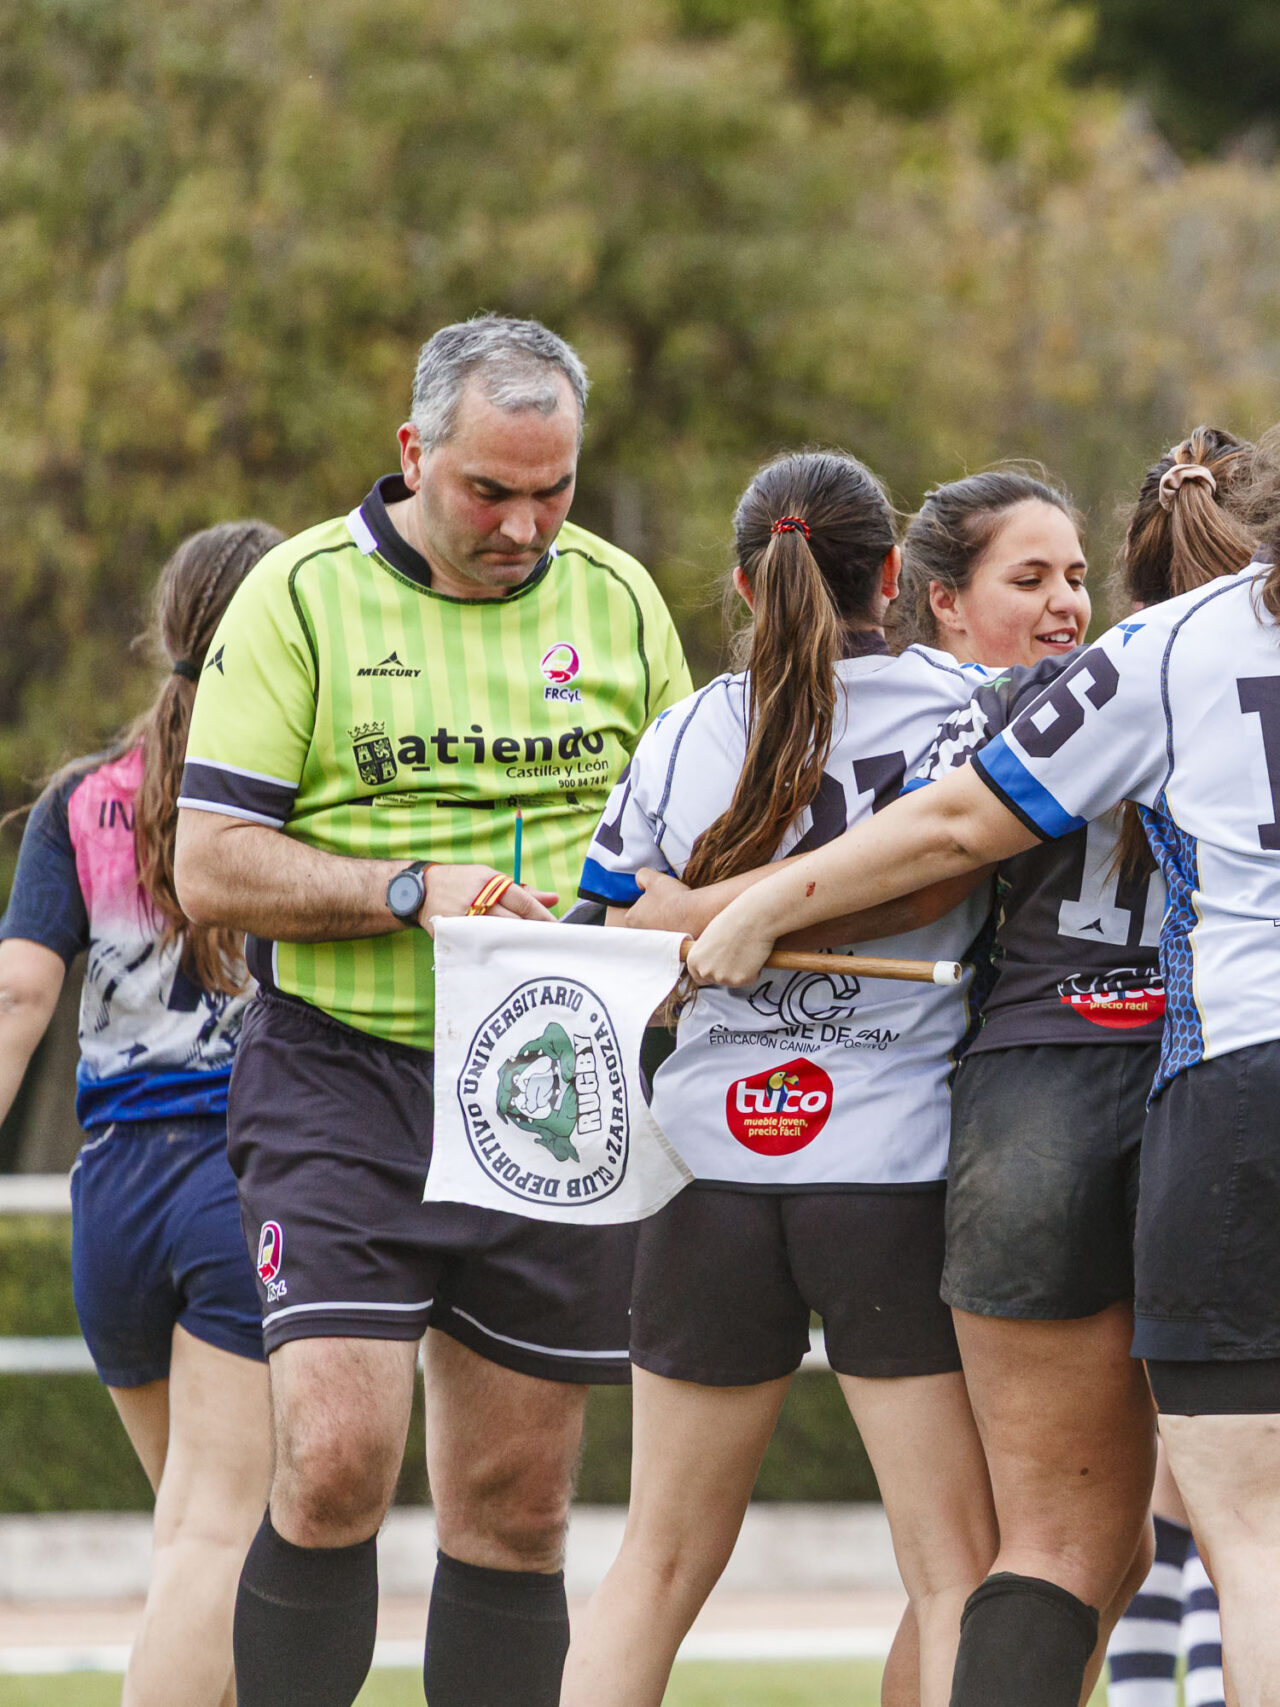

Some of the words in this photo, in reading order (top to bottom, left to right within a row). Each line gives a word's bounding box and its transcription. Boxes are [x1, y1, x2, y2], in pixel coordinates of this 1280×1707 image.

[356, 668, 421, 677] MERCURY
[544, 687, 582, 702] FRCyL
[397, 724, 604, 767] atiendo
[506, 764, 560, 778] Castilla
[565, 765, 573, 777] y
[577, 759, 609, 773] León
[558, 779, 576, 788] 900
[463, 985, 584, 1095] UNIVERSITARIO
[573, 1034, 602, 1136] RUGBY
[594, 1021, 625, 1157] ZARAGOZA
[736, 1080, 828, 1114] tuco
[743, 1116, 778, 1127] mueble
[778, 1116, 809, 1128] joven,
[748, 1127, 778, 1138] precio
[779, 1125, 801, 1137] fácil
[468, 1103, 561, 1198] DEPORTIVO
[567, 1165, 615, 1198] CLUB
